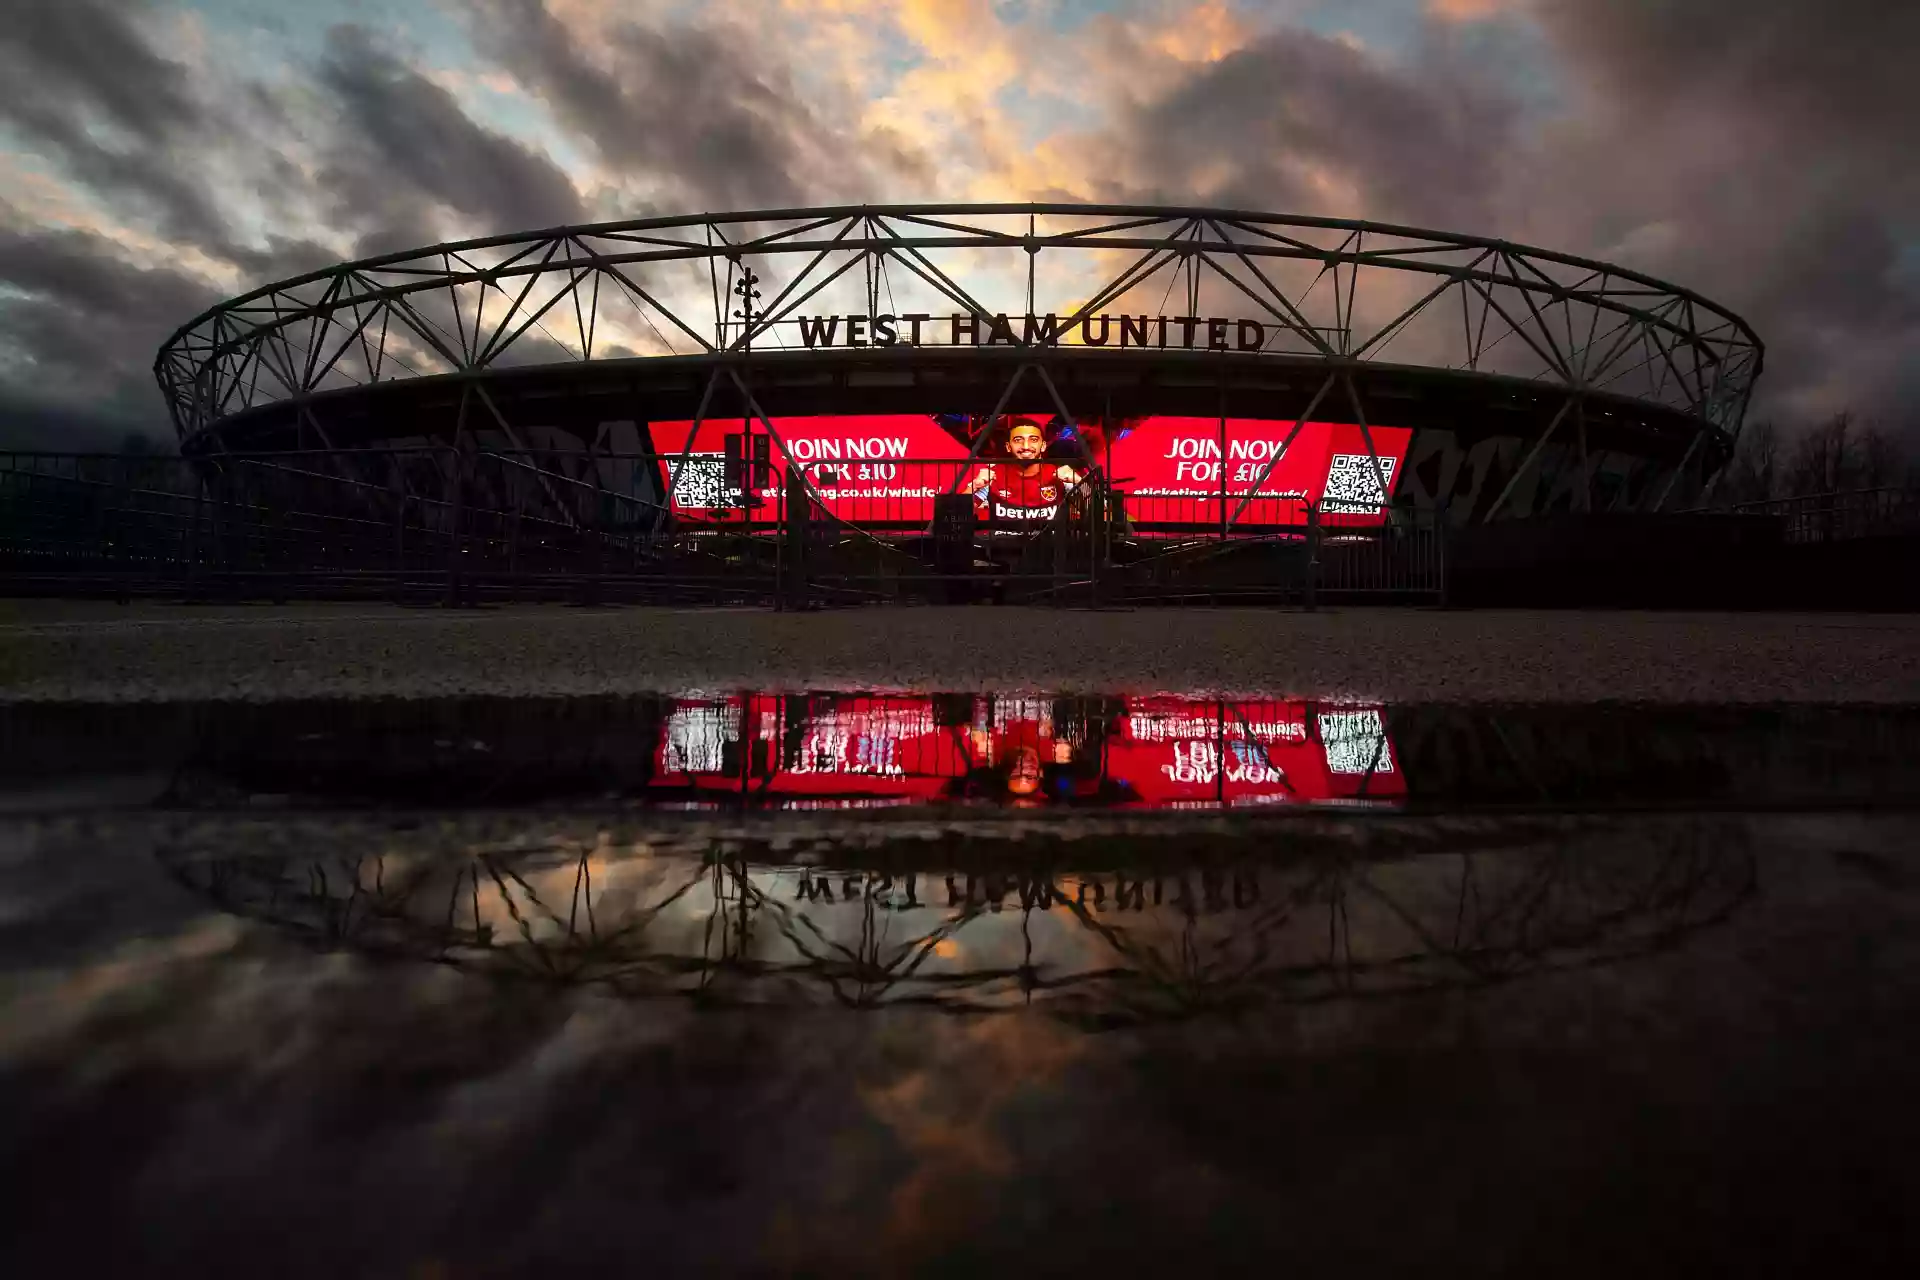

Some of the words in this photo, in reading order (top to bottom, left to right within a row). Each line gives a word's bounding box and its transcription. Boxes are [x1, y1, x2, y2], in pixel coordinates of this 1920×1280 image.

[799, 314, 930, 347] WEST
[951, 313, 1058, 347] HAM
[1081, 314, 1265, 352] UNITED
[781, 438, 841, 459] JOIN
[845, 437, 909, 458] NOW
[1163, 438, 1223, 459] JOIN
[858, 461, 896, 481] £10
[1176, 461, 1228, 482] FOR
[995, 503, 1058, 520] betway
